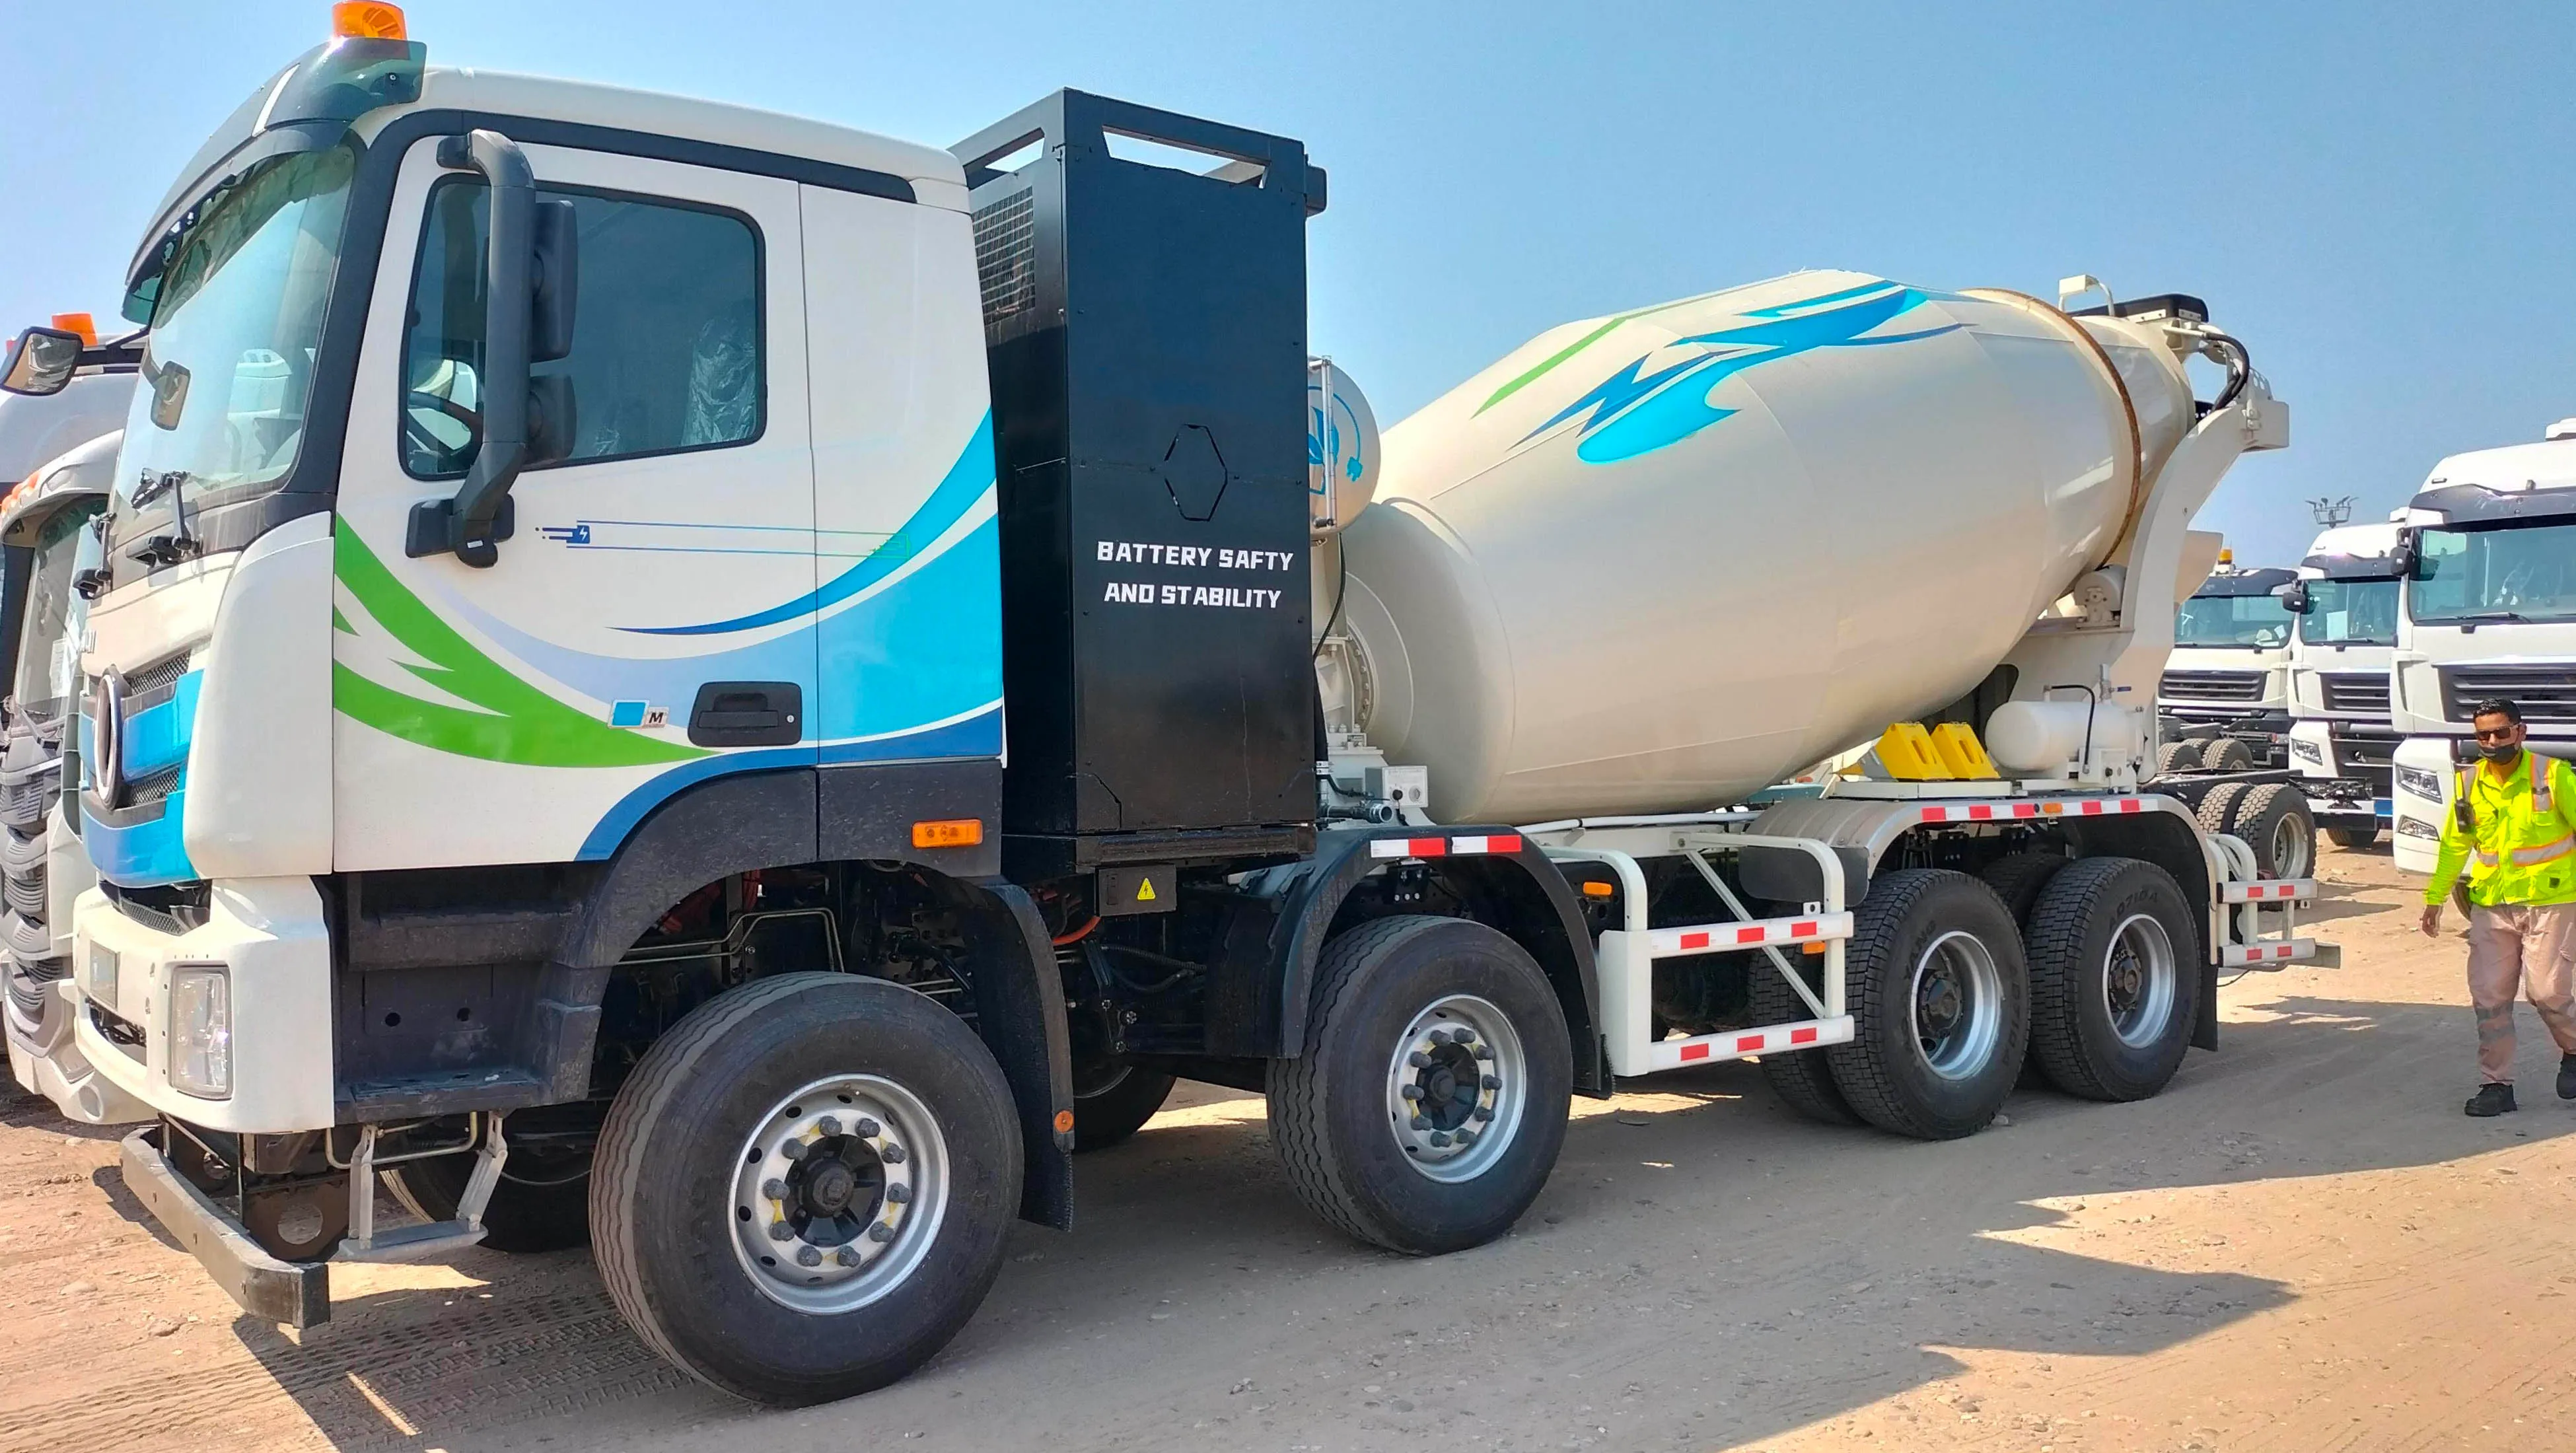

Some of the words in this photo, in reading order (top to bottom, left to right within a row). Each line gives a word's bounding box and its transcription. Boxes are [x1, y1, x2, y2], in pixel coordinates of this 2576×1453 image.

[1098, 542, 1211, 566] BATTERY
[1219, 549, 1293, 570] SAFTY
[1104, 583, 1155, 603] AND
[1162, 585, 1281, 608] STABILITY
[649, 712, 664, 724] M
